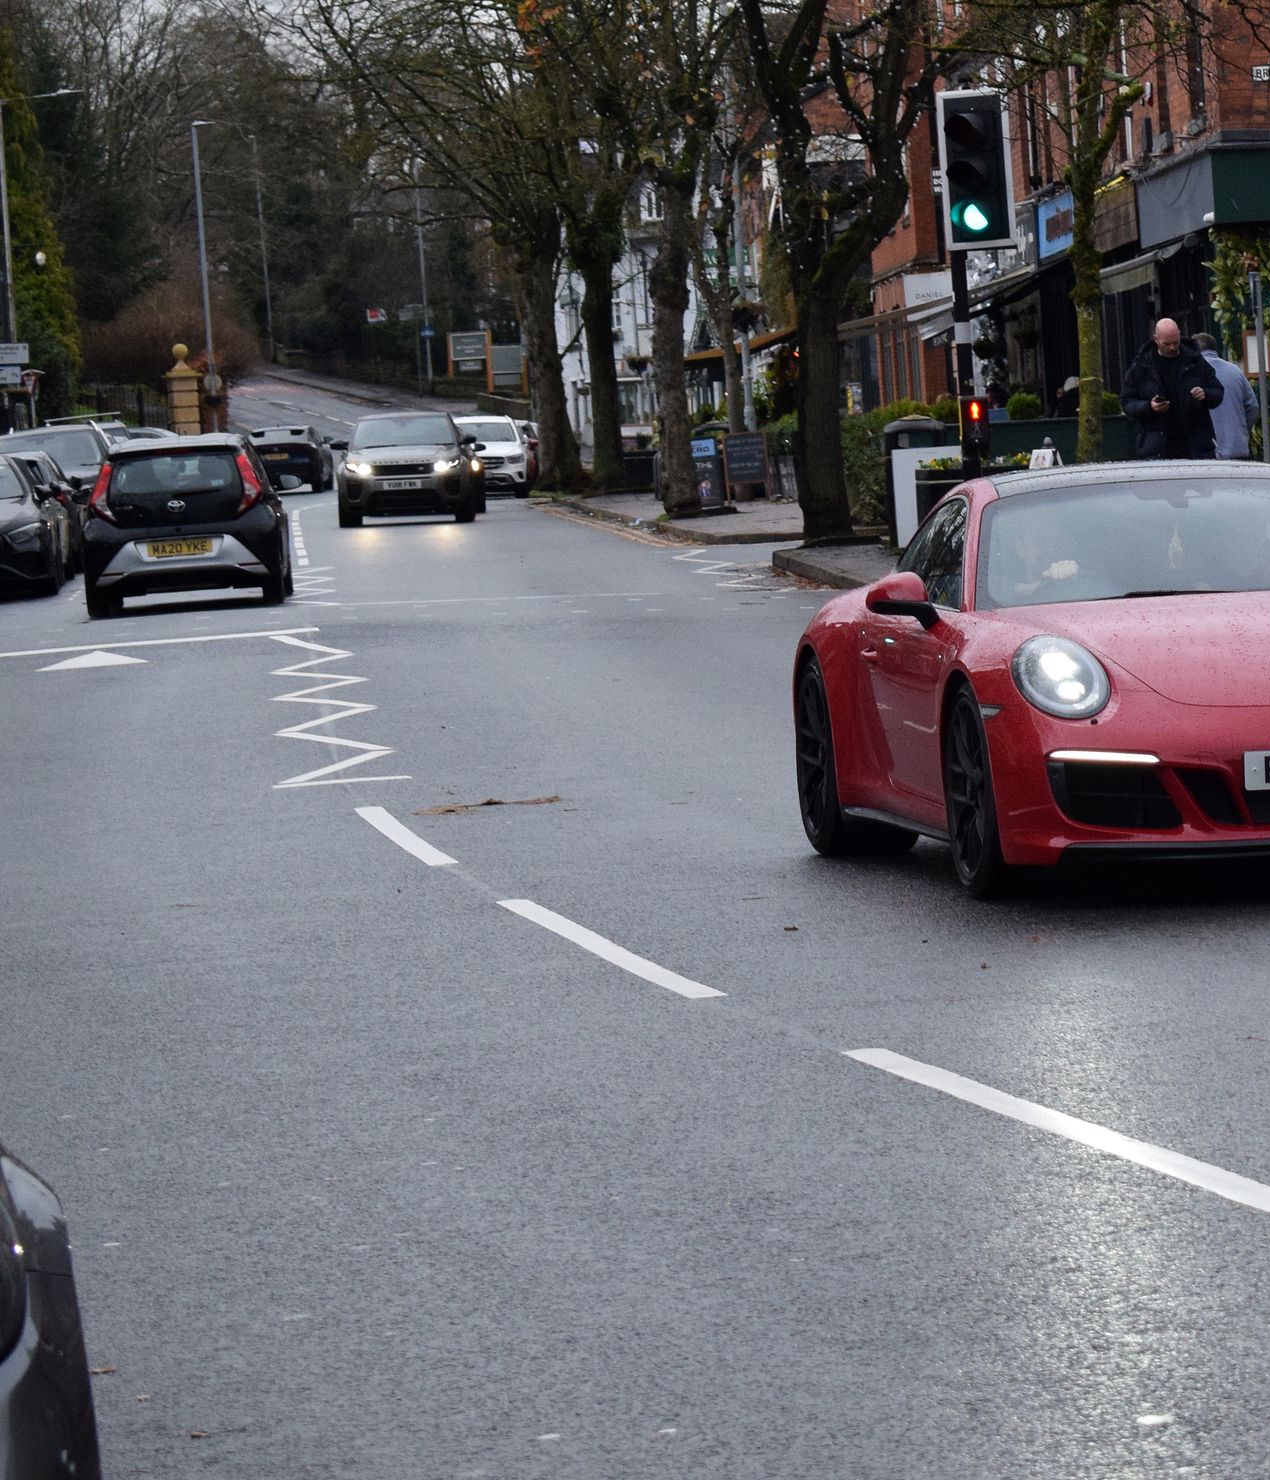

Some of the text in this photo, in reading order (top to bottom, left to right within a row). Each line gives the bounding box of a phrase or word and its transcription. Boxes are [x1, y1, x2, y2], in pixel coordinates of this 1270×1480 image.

[915, 291, 943, 299] DANIEL
[152, 540, 208, 555] MA20 YKE
